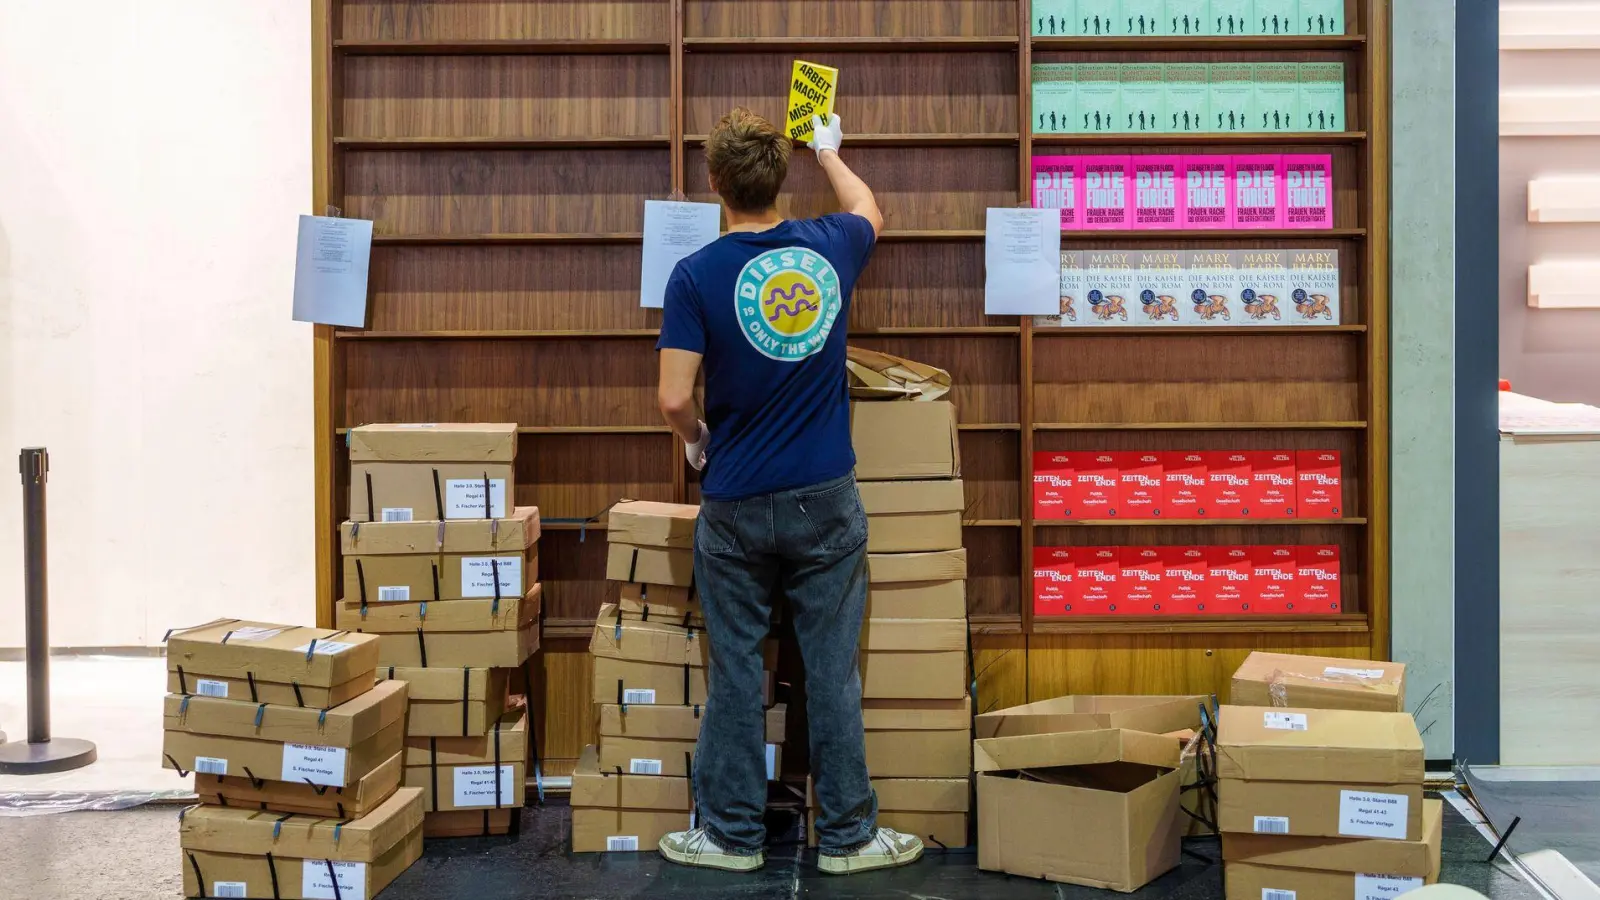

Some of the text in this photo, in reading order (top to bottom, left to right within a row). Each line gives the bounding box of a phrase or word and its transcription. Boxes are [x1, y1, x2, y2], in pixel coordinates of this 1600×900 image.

[799, 64, 832, 94] ARBEIT
[792, 79, 828, 106] MACHT
[790, 113, 828, 140] BRAUH
[1036, 172, 1074, 189] DIE
[1086, 172, 1124, 188] DIE
[1137, 172, 1174, 188] DIE
[1187, 171, 1225, 188] DIE
[1237, 171, 1274, 188] DIE
[1288, 171, 1325, 188] DIE
[1091, 254, 1128, 263] MARY
[1142, 254, 1180, 263] MARY
[1193, 254, 1230, 262] MARY
[1244, 253, 1281, 262] MARY
[1295, 253, 1332, 262] MARY
[740, 252, 830, 300] DIESEL
[743, 306, 755, 316] 19
[750, 302, 836, 354] ONLY THE WAVES
